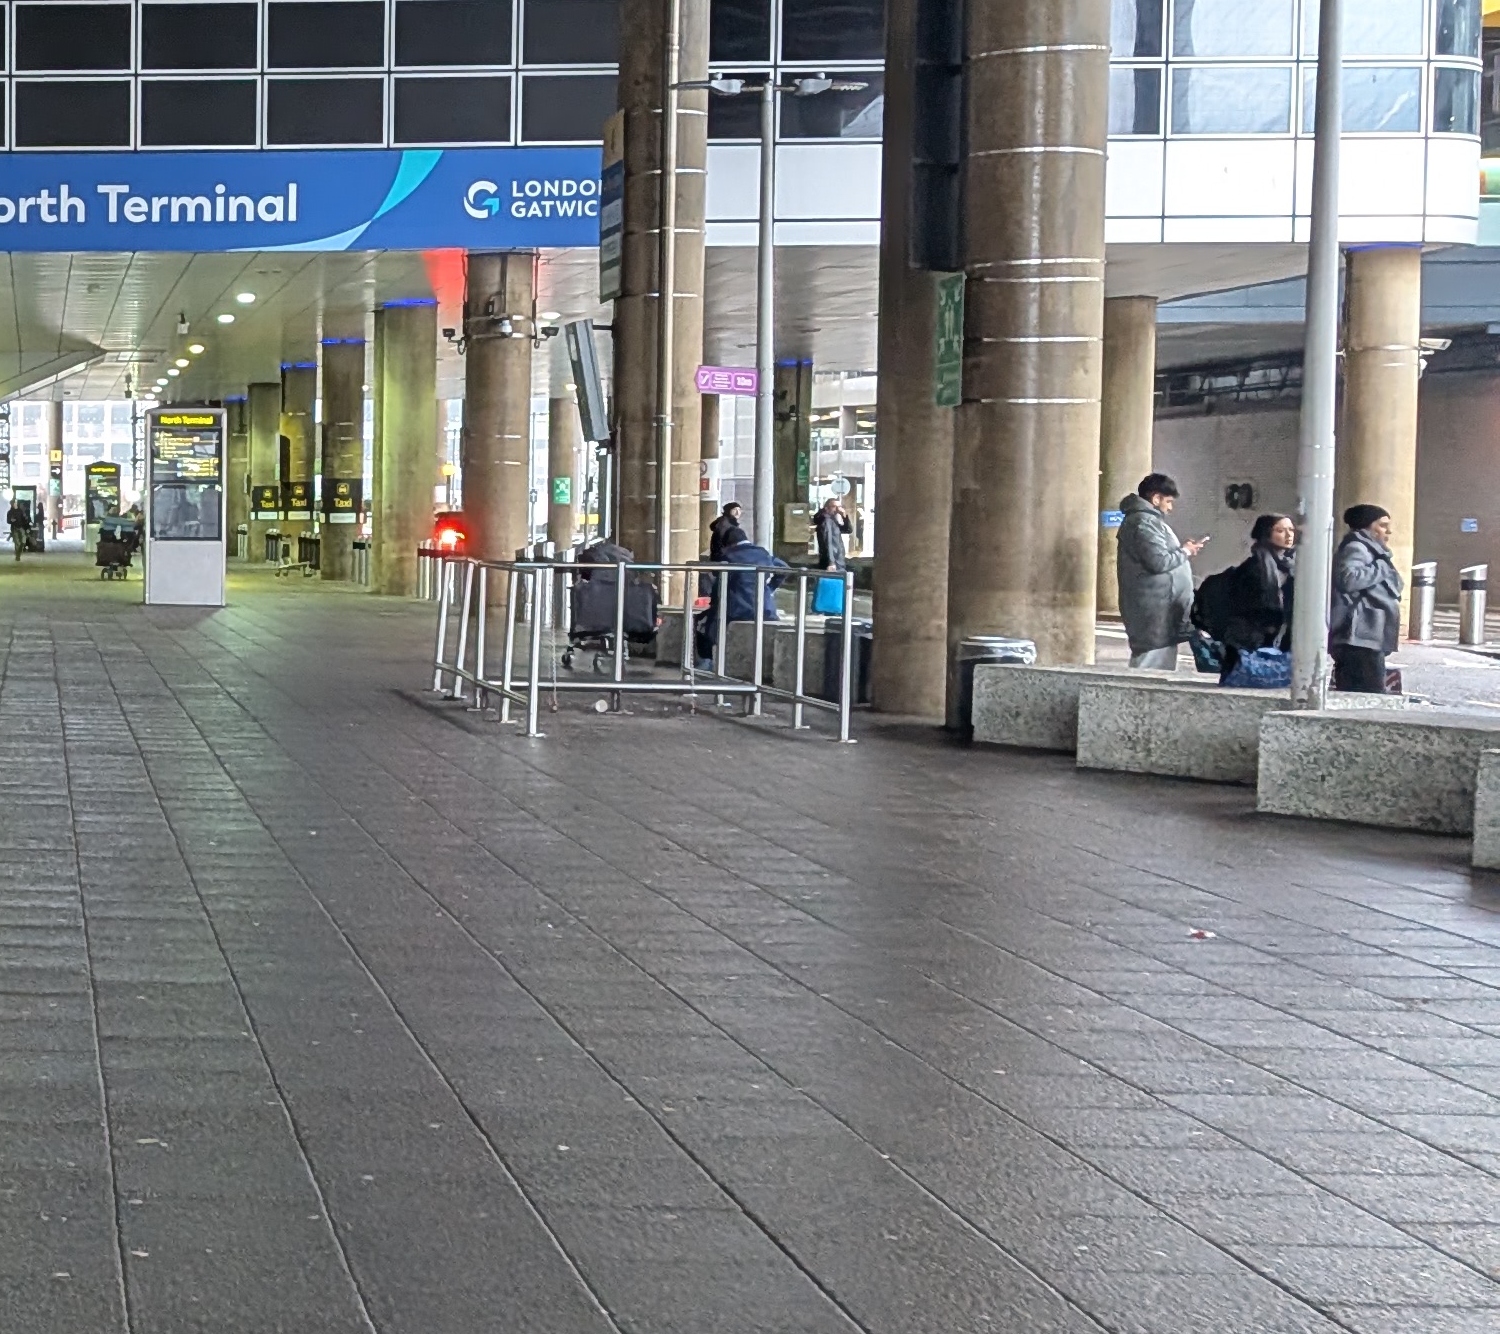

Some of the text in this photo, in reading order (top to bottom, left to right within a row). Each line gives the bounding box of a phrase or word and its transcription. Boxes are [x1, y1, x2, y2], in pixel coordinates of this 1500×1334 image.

[97, 183, 297, 223] Terminal
[510, 199, 598, 218] GATWIC
[290, 497, 307, 507] Taxi
[333, 497, 353, 508] Taxi
